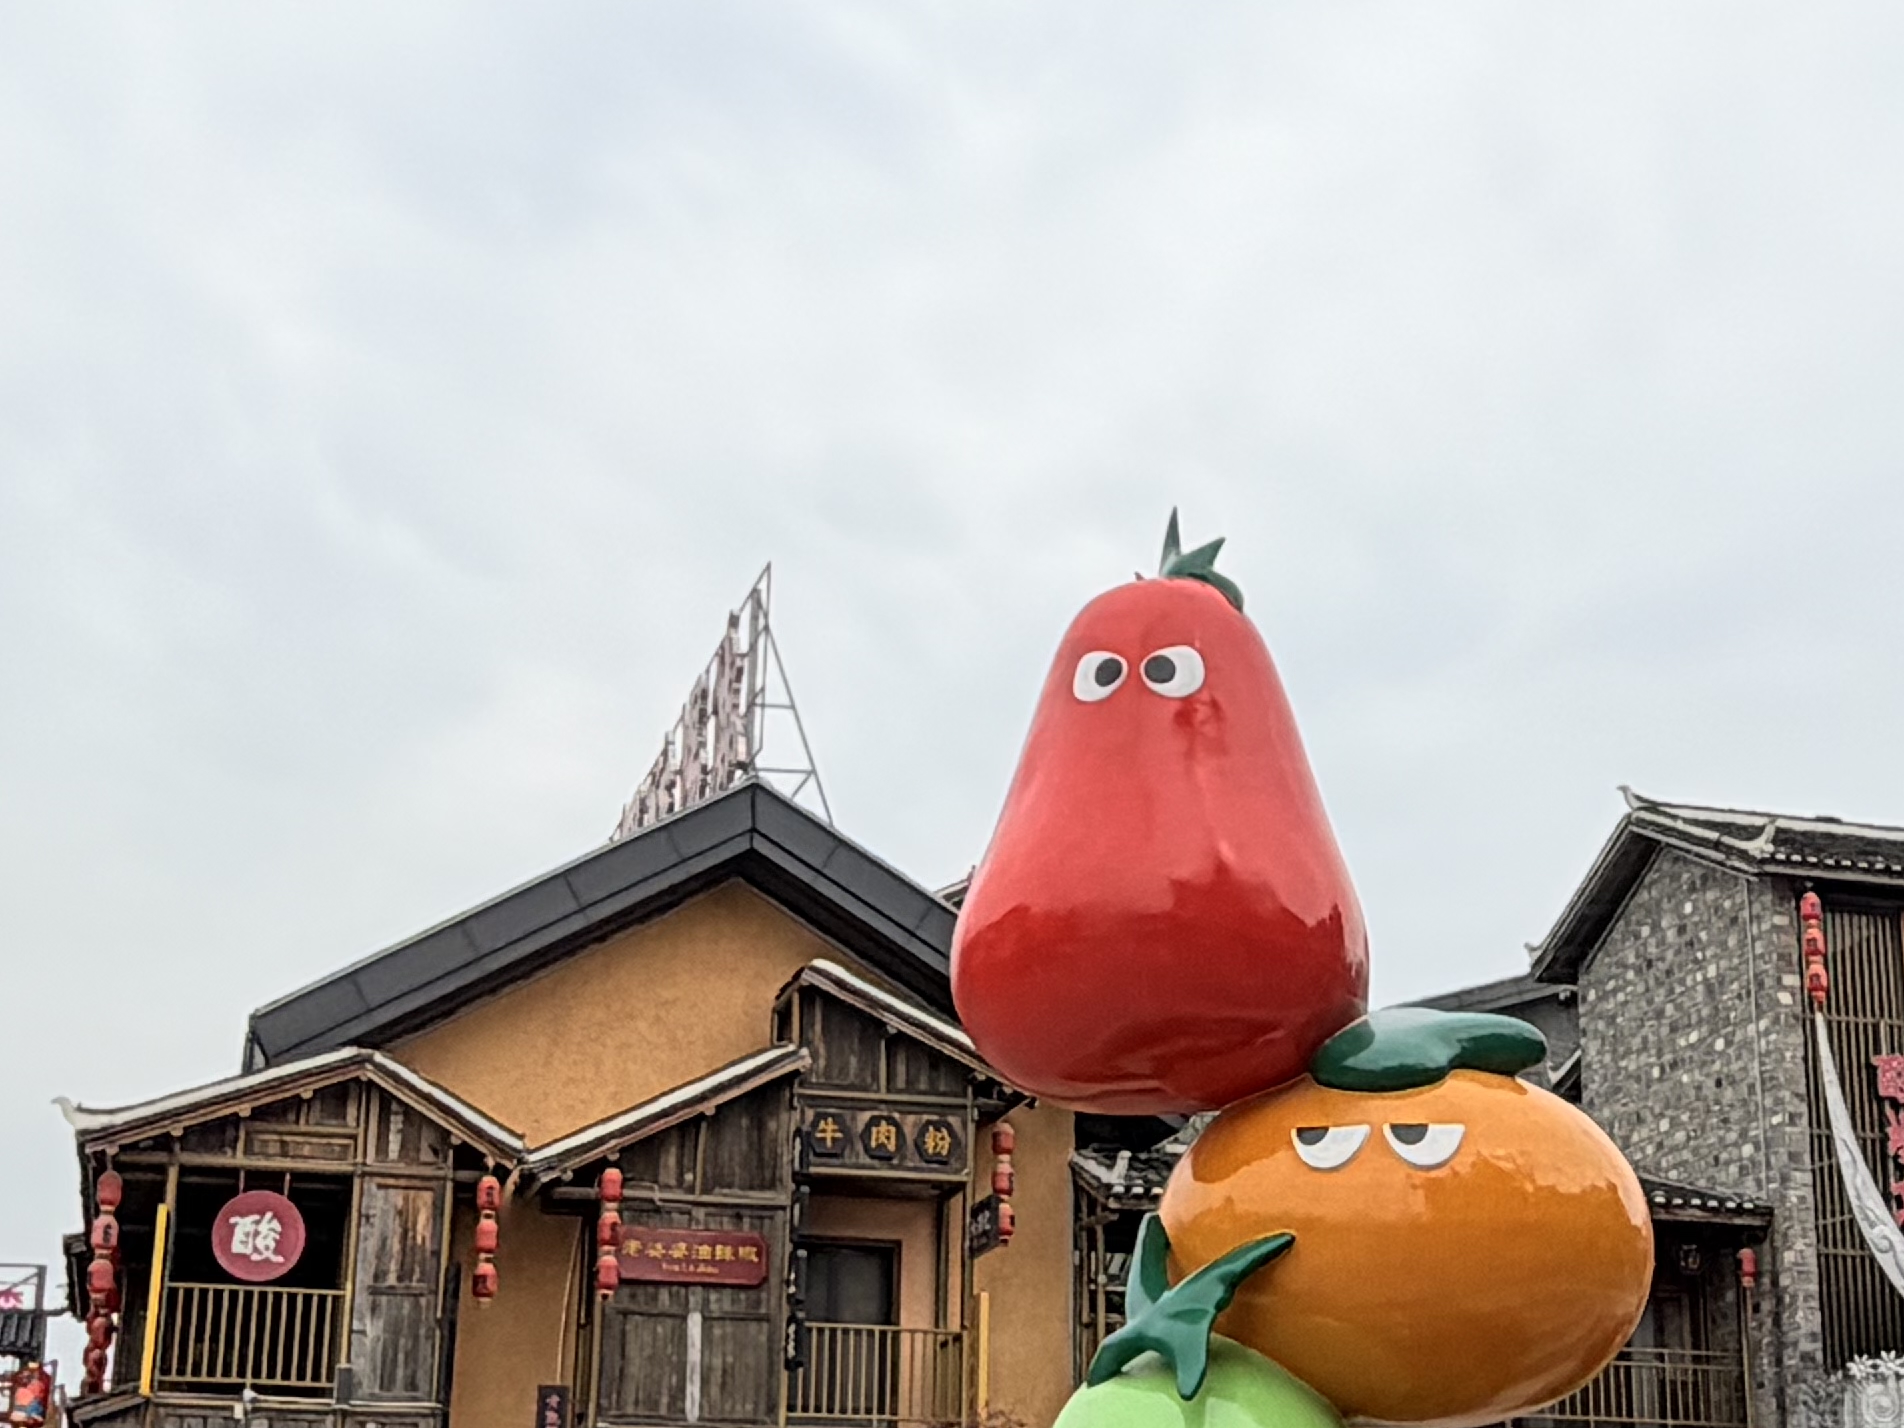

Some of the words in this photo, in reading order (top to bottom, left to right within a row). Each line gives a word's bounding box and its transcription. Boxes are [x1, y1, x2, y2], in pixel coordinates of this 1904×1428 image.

[815, 1116, 951, 1157] 牛肉粉
[228, 1211, 286, 1263] 酸
